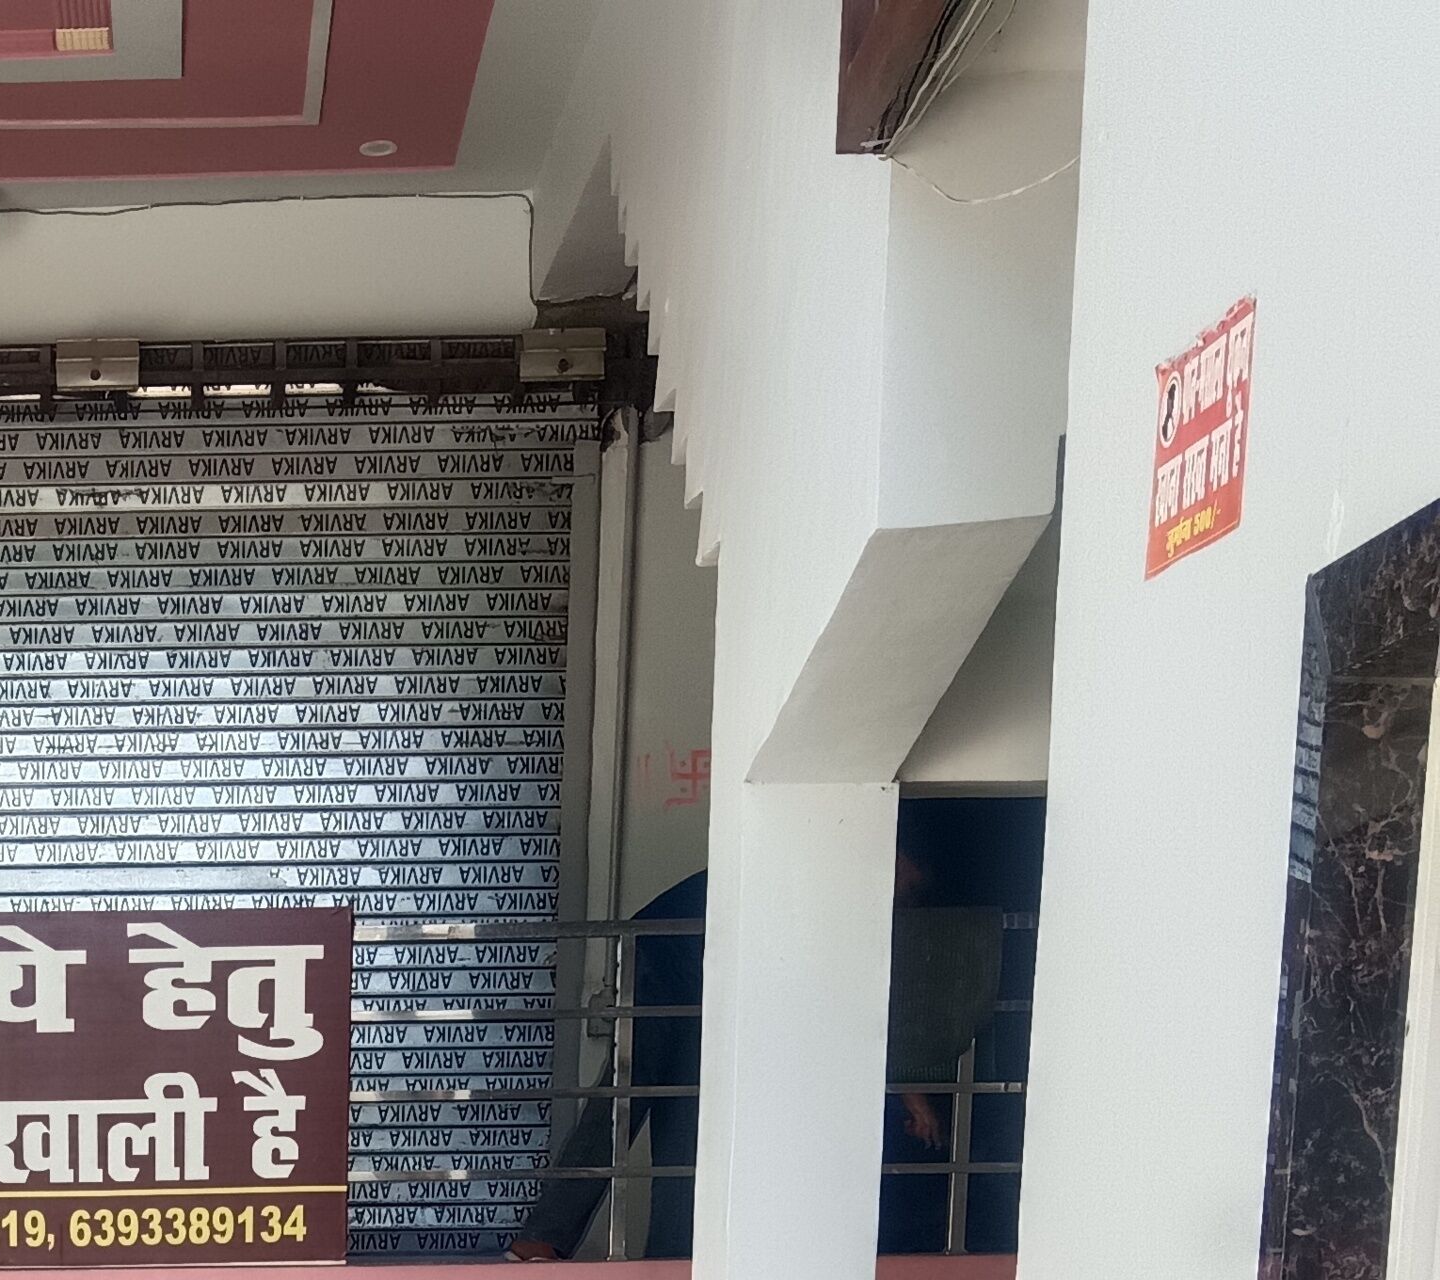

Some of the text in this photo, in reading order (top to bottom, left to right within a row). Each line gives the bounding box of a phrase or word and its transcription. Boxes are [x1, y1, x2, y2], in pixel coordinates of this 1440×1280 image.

[36, 431, 104, 451] ARVIKA
[284, 427, 352, 447] ARVIKA
[1210, 418, 1232, 492] मना
[1232, 391, 1243, 478] है
[106, 459, 174, 479] ARVIKA
[354, 455, 422, 475] ARVIKA
[220, 484, 288, 504] ARVIKA
[54, 516, 122, 536] ARVIKA
[300, 512, 368, 532] ARVIKA
[134, 541, 202, 561] ARVIKA
[382, 538, 450, 558] ARVIKA
[190, 568, 258, 588] ARVIKA
[436, 565, 504, 585] ARVIKA
[74, 597, 142, 617] ARVIKA
[322, 594, 390, 614] ARVIKA
[174, 623, 242, 643] ARVIKA
[420, 620, 488, 640] ARVIKA
[4, 653, 68, 672] ARVIKA
[248, 649, 316, 669] ARVIKA
[494, 647, 562, 667] ARVIKA
[458, 702, 526, 722] ARVIKA
[440, 729, 508, 749] ARVIKA
[344, 756, 492, 776] ARVIKA ARVIKA
[212, 785, 278, 804] ARVIKA
[456, 783, 522, 802] ARVIKA
[402, 811, 466, 830] ARVIKA
[358, 838, 504, 857] ARVIKA ARVIKA
[460, 865, 524, 884] ARVIKA
[496, 892, 560, 911] ARVIKA
[394, 945, 540, 965] ARVIKA ARVIKA
[388, 971, 534, 990] ARVIKA ARVIKA
[127, 922, 325, 1061] हेतु
[424, 1025, 488, 1044] ARVIKA
[402, 1050, 548, 1070] ARVIKA ARVIKA
[378, 1103, 522, 1123] ARVIKA ARVIKA
[231, 1068, 306, 1180] है
[388, 1128, 534, 1148] ARVIKA ARVIKA
[408, 1180, 472, 1199] ARVIKA
[354, 1205, 498, 1225] ARVIKA ARVIKA
[68, 1205, 307, 1247] 6393389134
